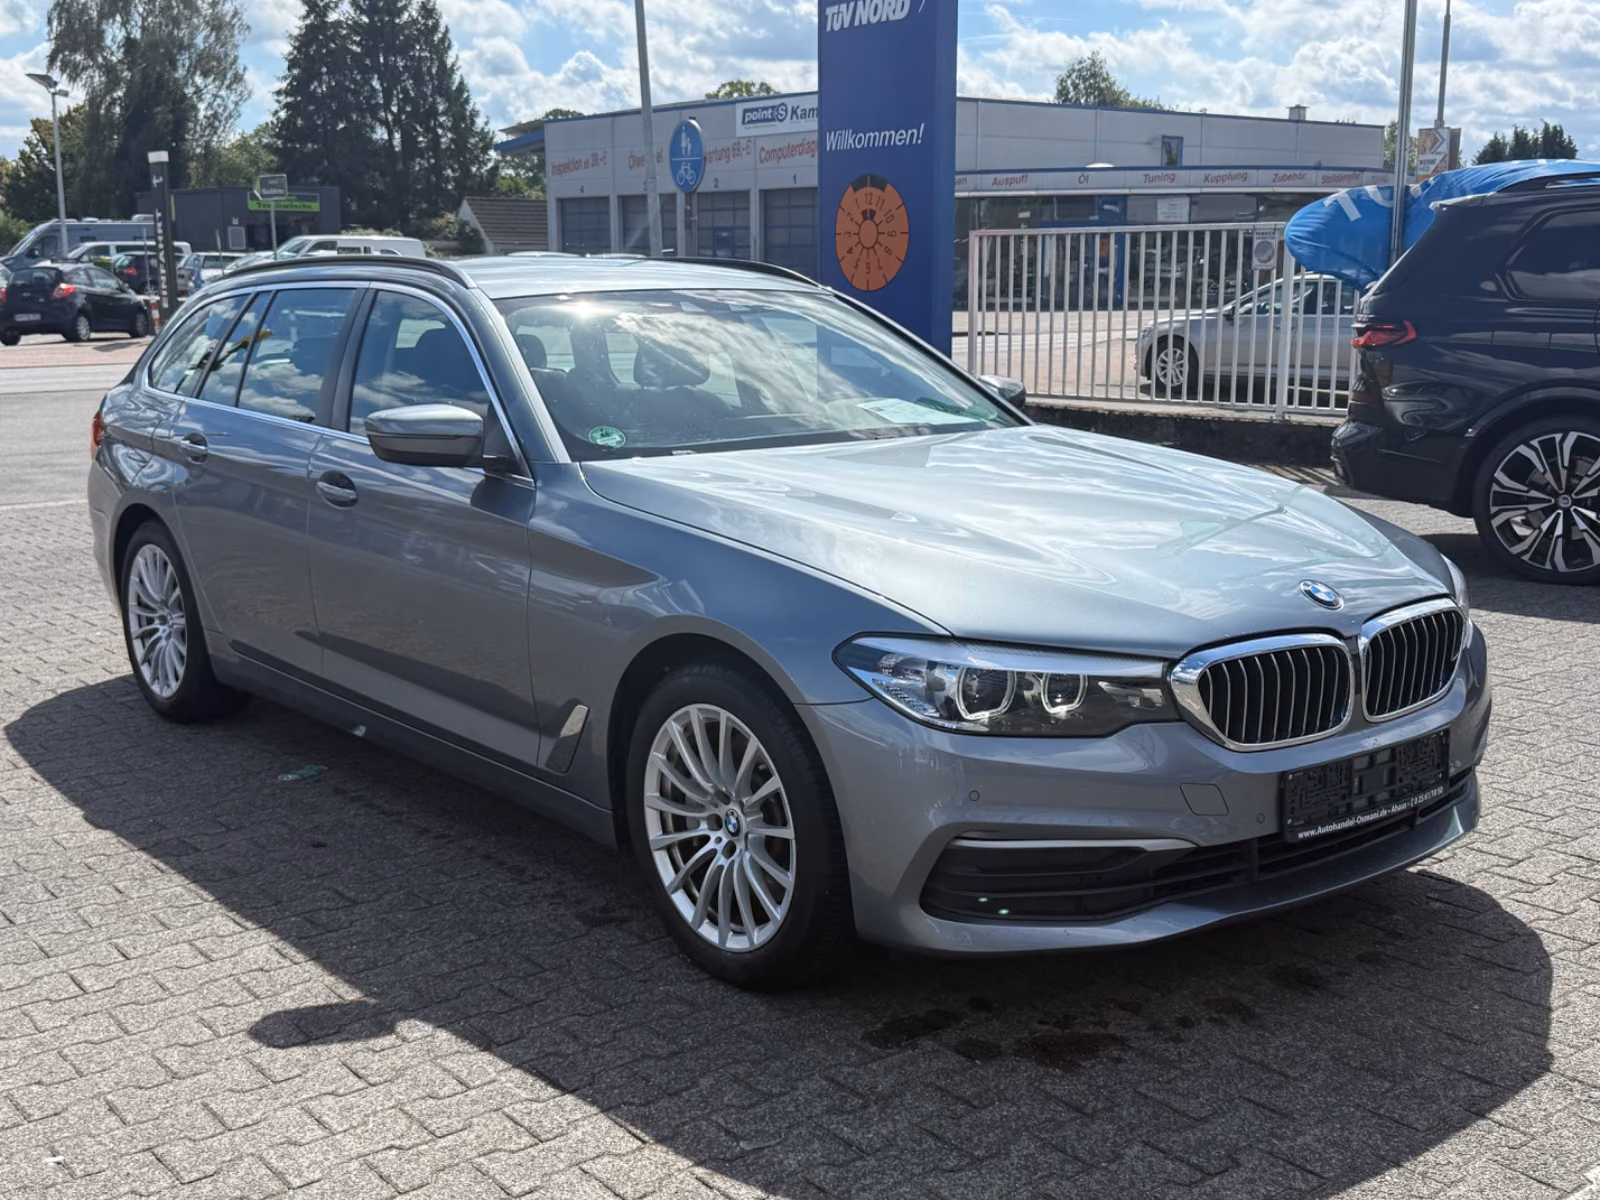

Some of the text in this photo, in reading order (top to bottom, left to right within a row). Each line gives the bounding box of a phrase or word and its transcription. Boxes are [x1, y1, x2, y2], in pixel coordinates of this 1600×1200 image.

[855, 0, 910, 26] NORD
[744, 107, 773, 123] point
[826, 123, 925, 151] Willkommen!
[759, 138, 818, 164] Computerdiag
[551, 157, 582, 177] Inspektion
[713, 178, 720, 189] 2
[792, 174, 798, 185] 1
[992, 173, 1029, 187] Auspuff
[1078, 173, 1090, 184] Öl
[1143, 172, 1176, 184] Tuning
[1203, 171, 1248, 184] Kupplung
[1298, 808, 1388, 839] www.Autohandel-Osmani.de
